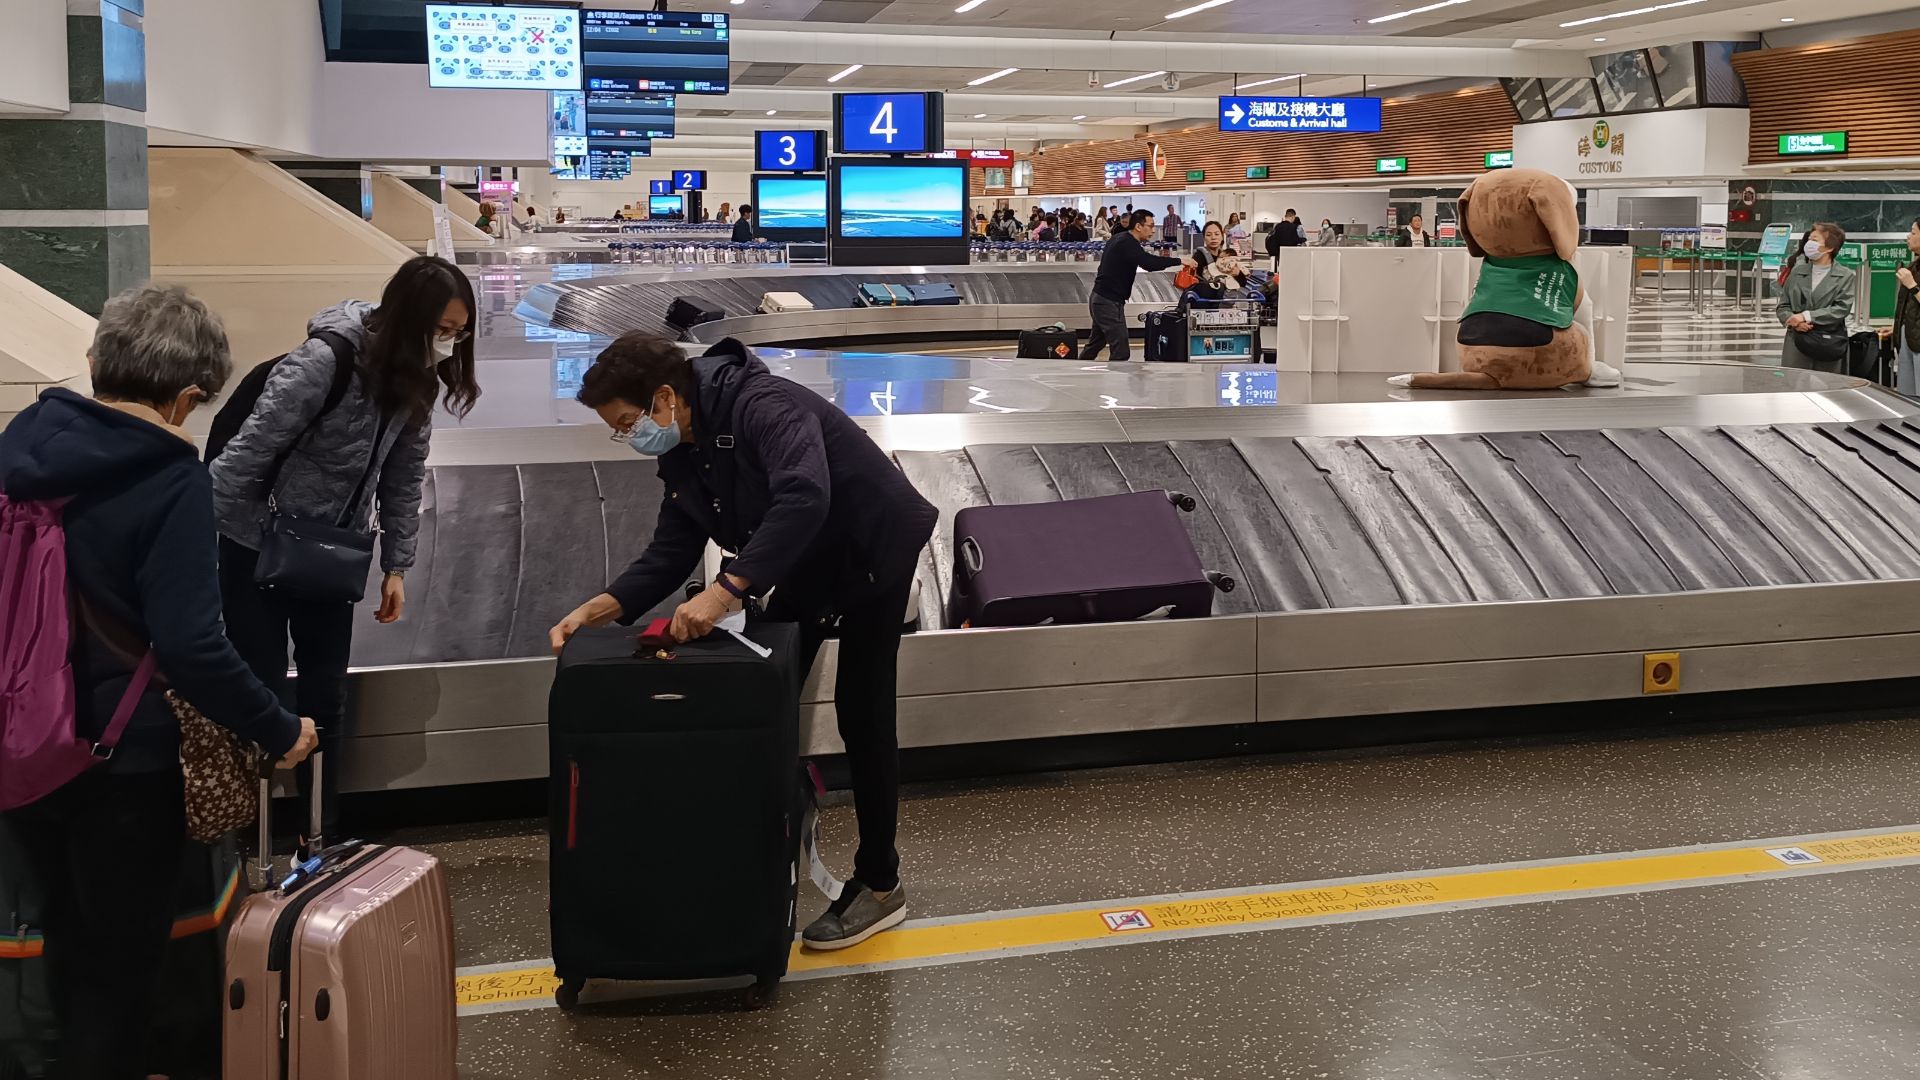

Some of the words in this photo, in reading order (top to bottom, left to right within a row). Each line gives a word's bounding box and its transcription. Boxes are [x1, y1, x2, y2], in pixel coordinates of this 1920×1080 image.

[1248, 102, 1345, 117] 海關及接機大廳
[869, 101, 898, 144] 4
[1248, 118, 1289, 128] Customs
[1290, 118, 1298, 128] &
[1300, 118, 1329, 128] Arrival
[1330, 118, 1348, 128] hall
[778, 135, 796, 166] 3
[1578, 160, 1623, 174] CUSTOMS
[656, 181, 664, 193] 1
[682, 172, 693, 188] 2
[1162, 918, 1190, 927] No
[1194, 913, 1246, 925] trolley
[1248, 906, 1316, 919] beyond
[1319, 904, 1346, 912] the
[1349, 898, 1402, 911] yellow
[1403, 894, 1435, 903] line
[468, 986, 543, 1002] behind
